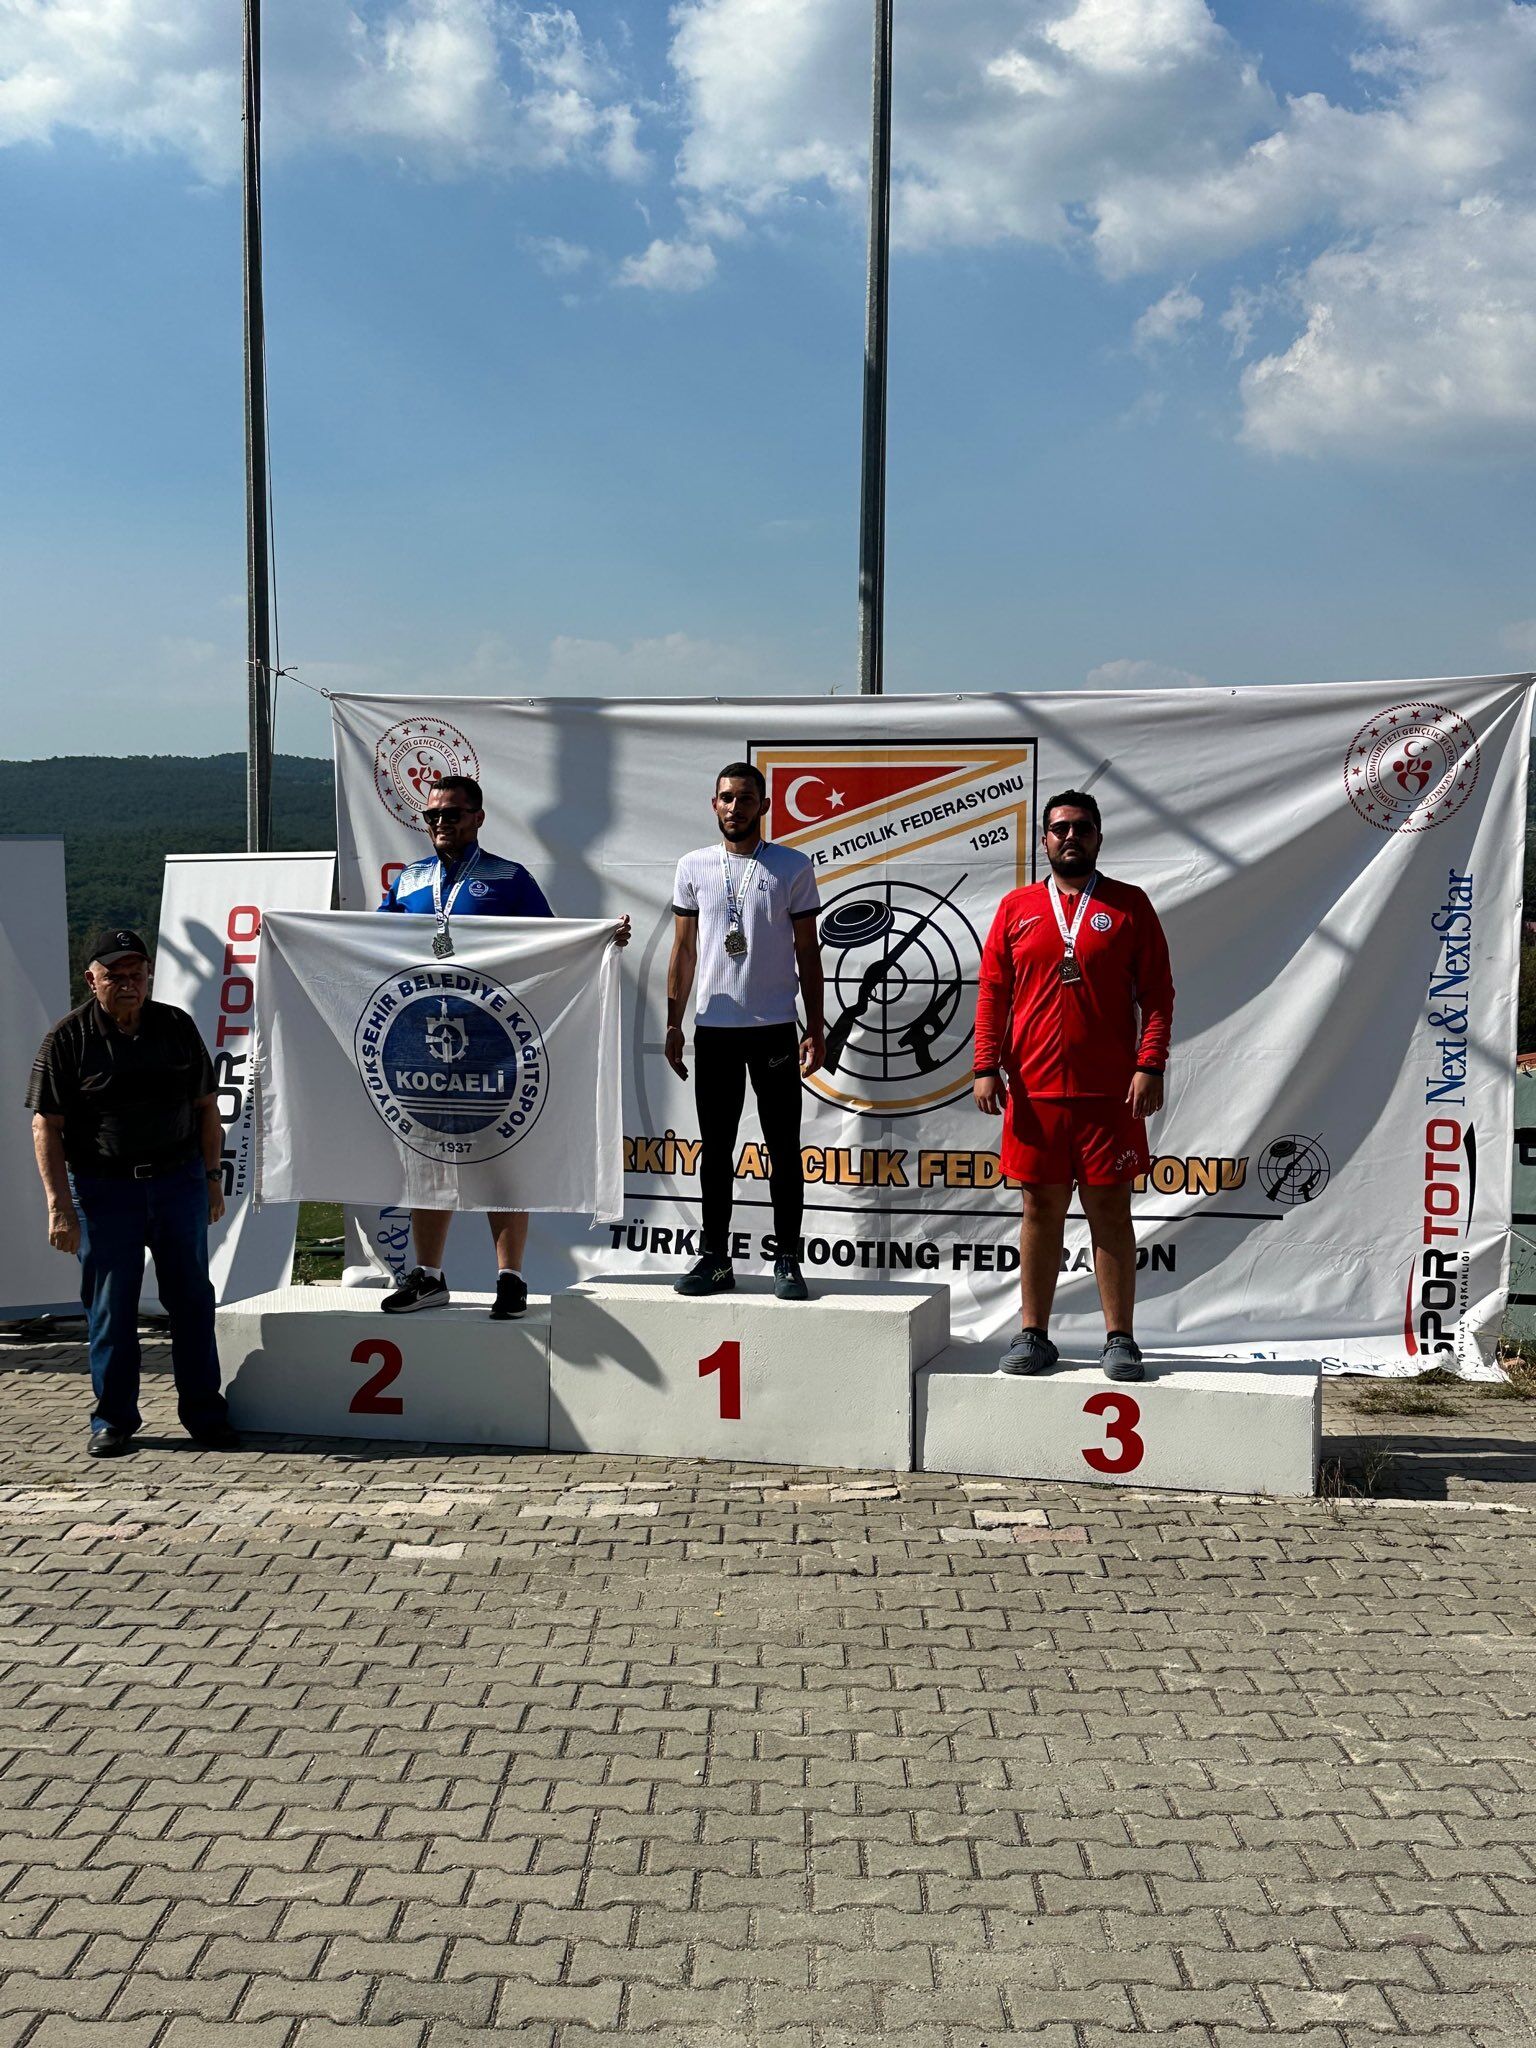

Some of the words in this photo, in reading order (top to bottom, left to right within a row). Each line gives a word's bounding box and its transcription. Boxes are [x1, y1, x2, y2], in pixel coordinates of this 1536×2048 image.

[414, 739, 444, 751] GENÇLİK
[444, 749, 453, 759] VE
[1402, 727, 1440, 739] GENÇLİK
[832, 823, 899, 860] ATICILIK
[900, 775, 1025, 833] FEDERASYONU
[969, 826, 1010, 851] 1923
[1428, 868, 1474, 1002] NextStar
[1427, 1003, 1469, 1035] &
[361, 992, 414, 1135] BÜYÜKŞEHİR
[398, 973, 507, 1013] BELEDİYE
[496, 1011, 543, 1139] KAĞITSPOR
[395, 1070, 505, 1093] KOCAELİ
[1425, 1037, 1469, 1107] Next
[438, 1141, 473, 1154] 1937
[733, 1142, 910, 1187] ACILIK
[349, 1339, 403, 1415] 2
[699, 1341, 740, 1419] 1
[1083, 1392, 1144, 1473] 3
